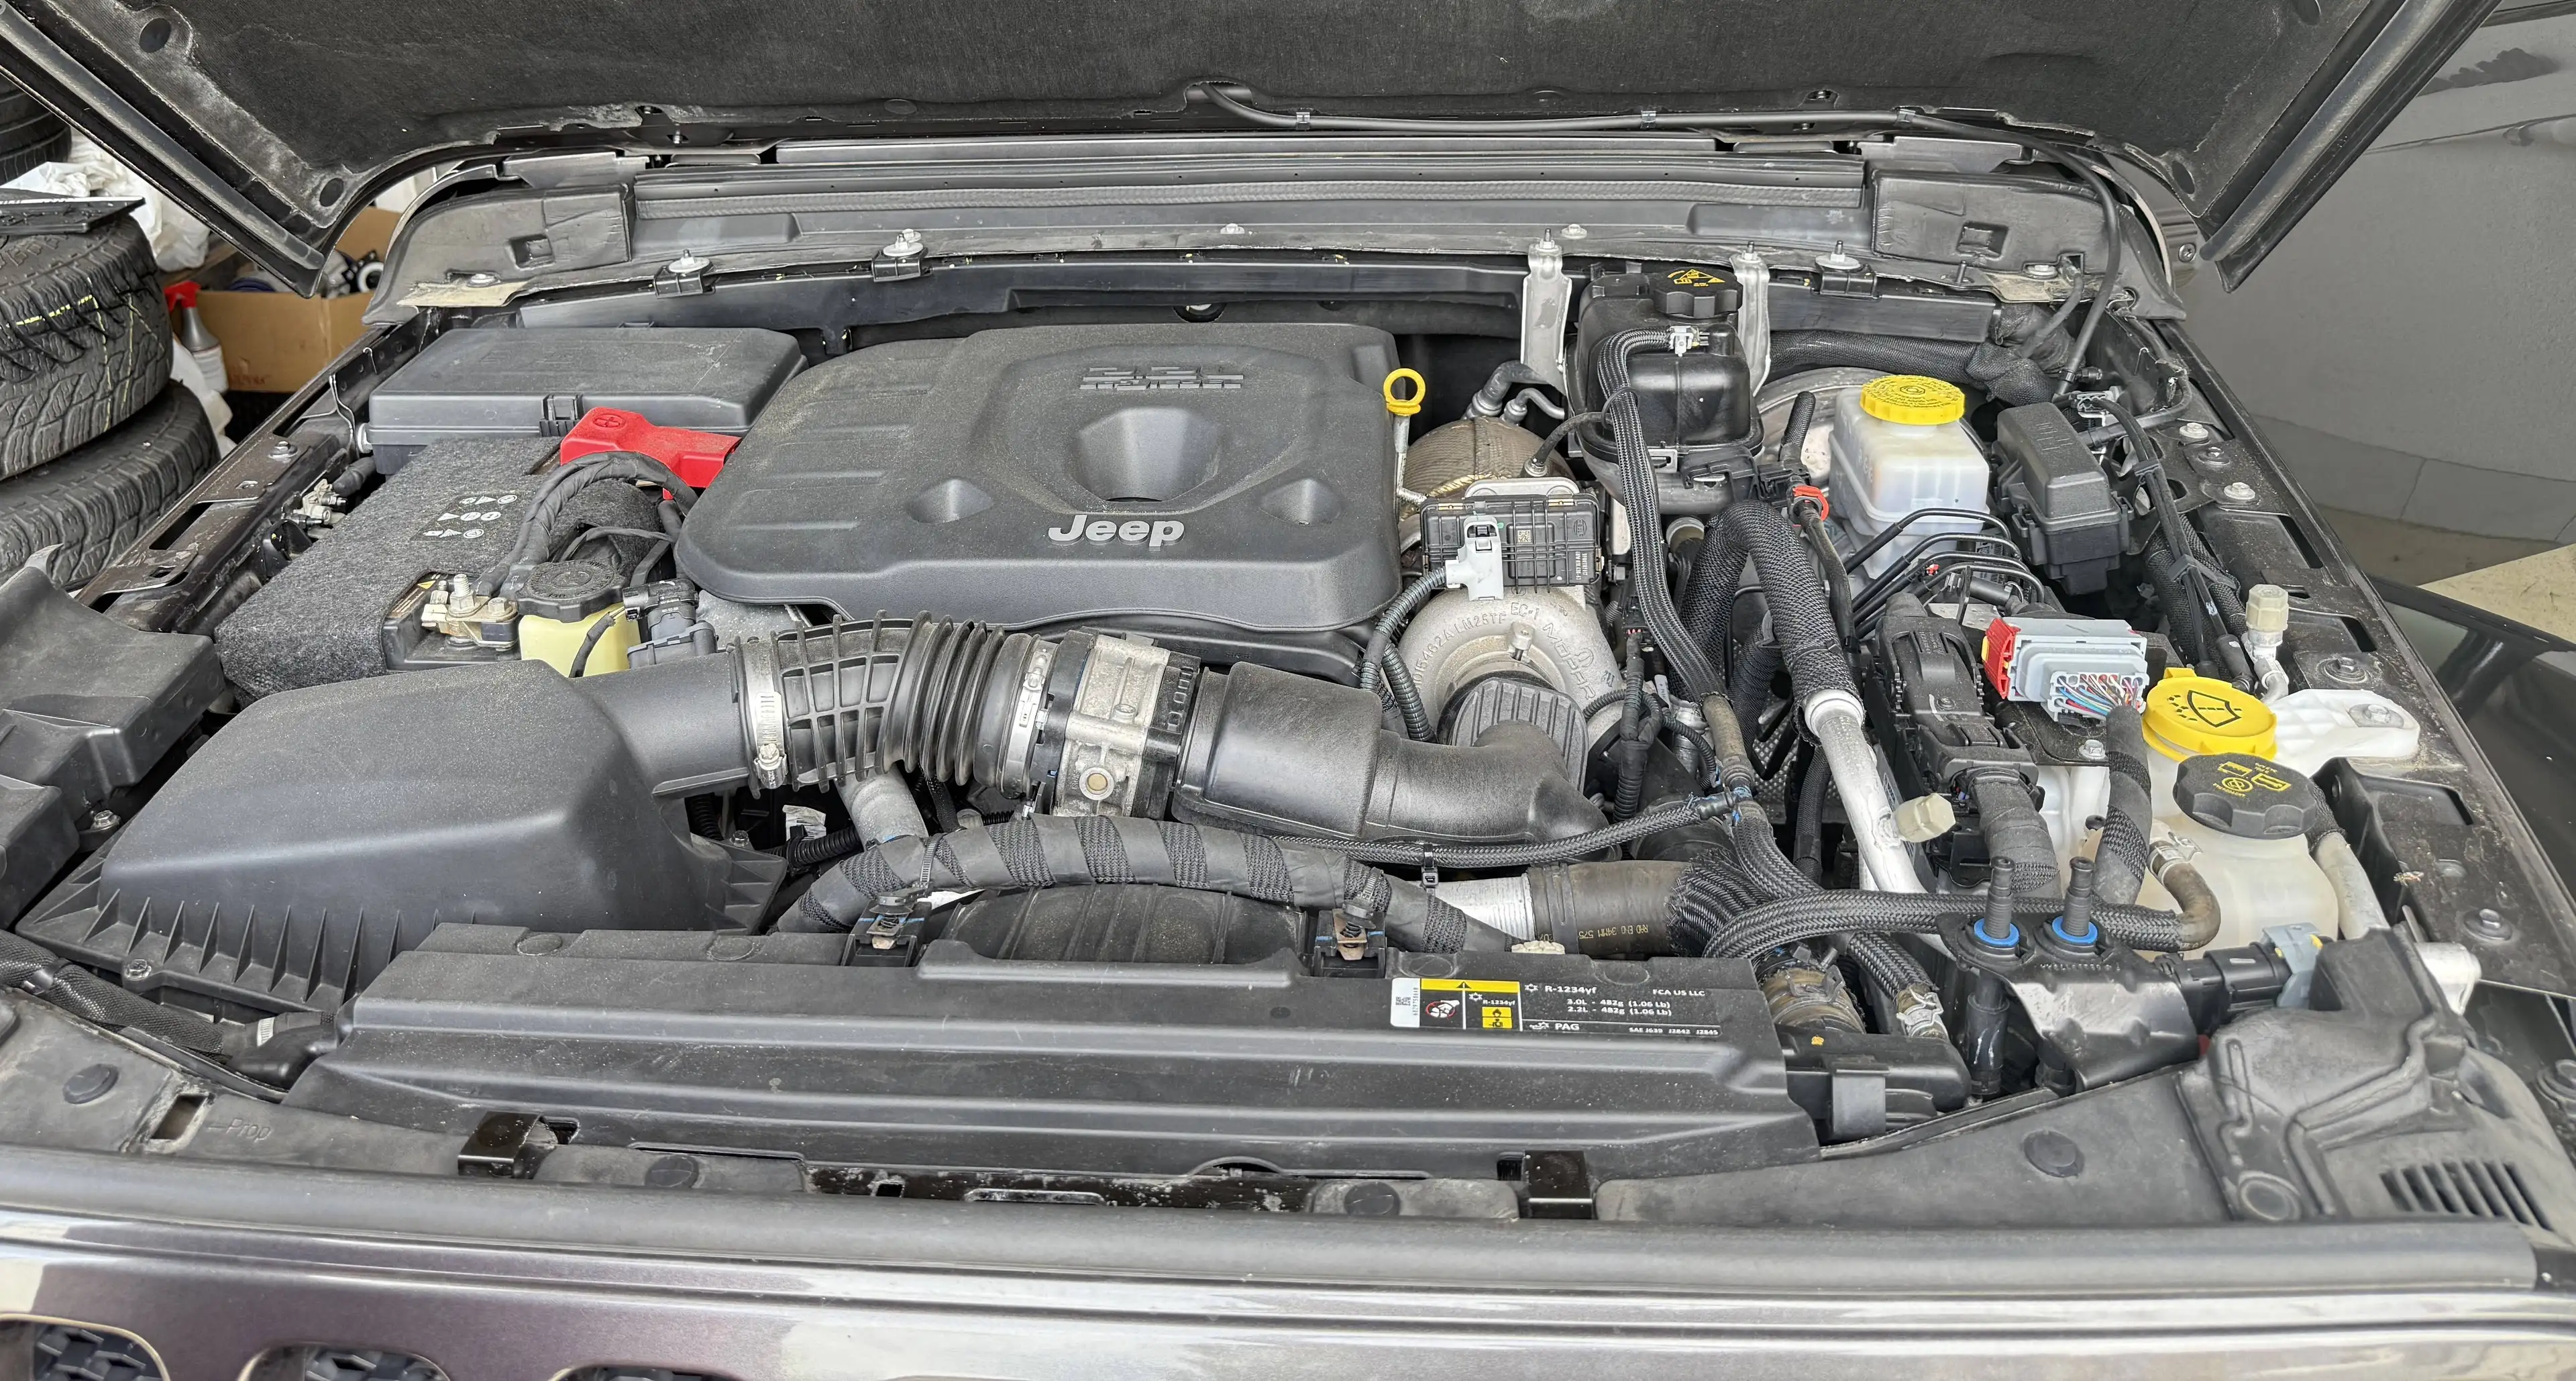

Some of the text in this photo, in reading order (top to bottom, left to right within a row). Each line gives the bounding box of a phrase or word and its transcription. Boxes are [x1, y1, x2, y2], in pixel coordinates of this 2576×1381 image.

[1048, 515, 1185, 550] Jeep
[1544, 985, 1597, 994] R-1234yf
[1600, 999, 1623, 1007] 482g
[1601, 1007, 1625, 1015] 482g
